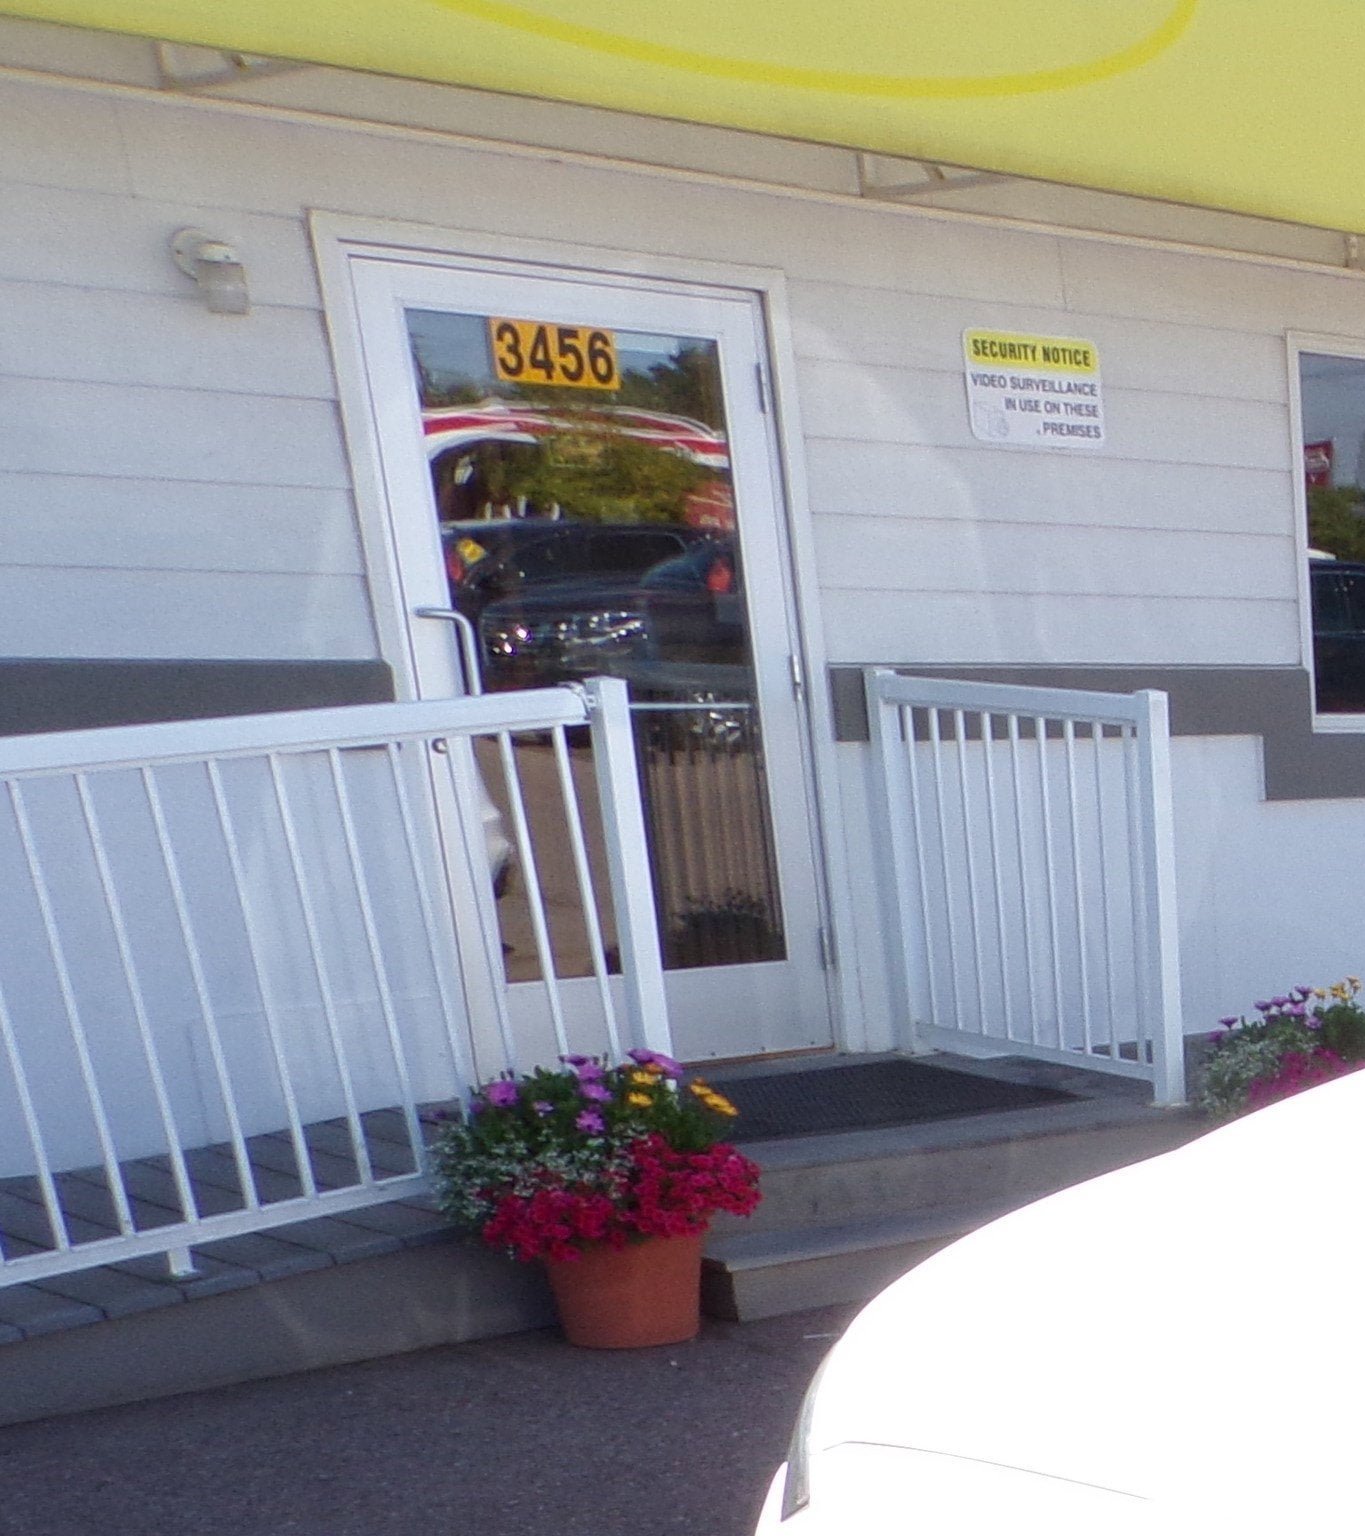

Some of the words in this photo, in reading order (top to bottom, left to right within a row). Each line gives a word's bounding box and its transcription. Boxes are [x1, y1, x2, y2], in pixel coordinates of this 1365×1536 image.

[496, 322, 614, 384] 3456
[972, 338, 1037, 363] SECURITY
[1042, 346, 1091, 368] NOTICE
[971, 373, 1007, 389] VIDEO
[1009, 376, 1098, 397] SURVEILLANCE
[1005, 398, 1017, 411] IN
[1019, 400, 1041, 413] USE
[1044, 401, 1060, 414] ON
[1064, 403, 1099, 418] THESE
[1042, 422, 1102, 439] PREMISES
